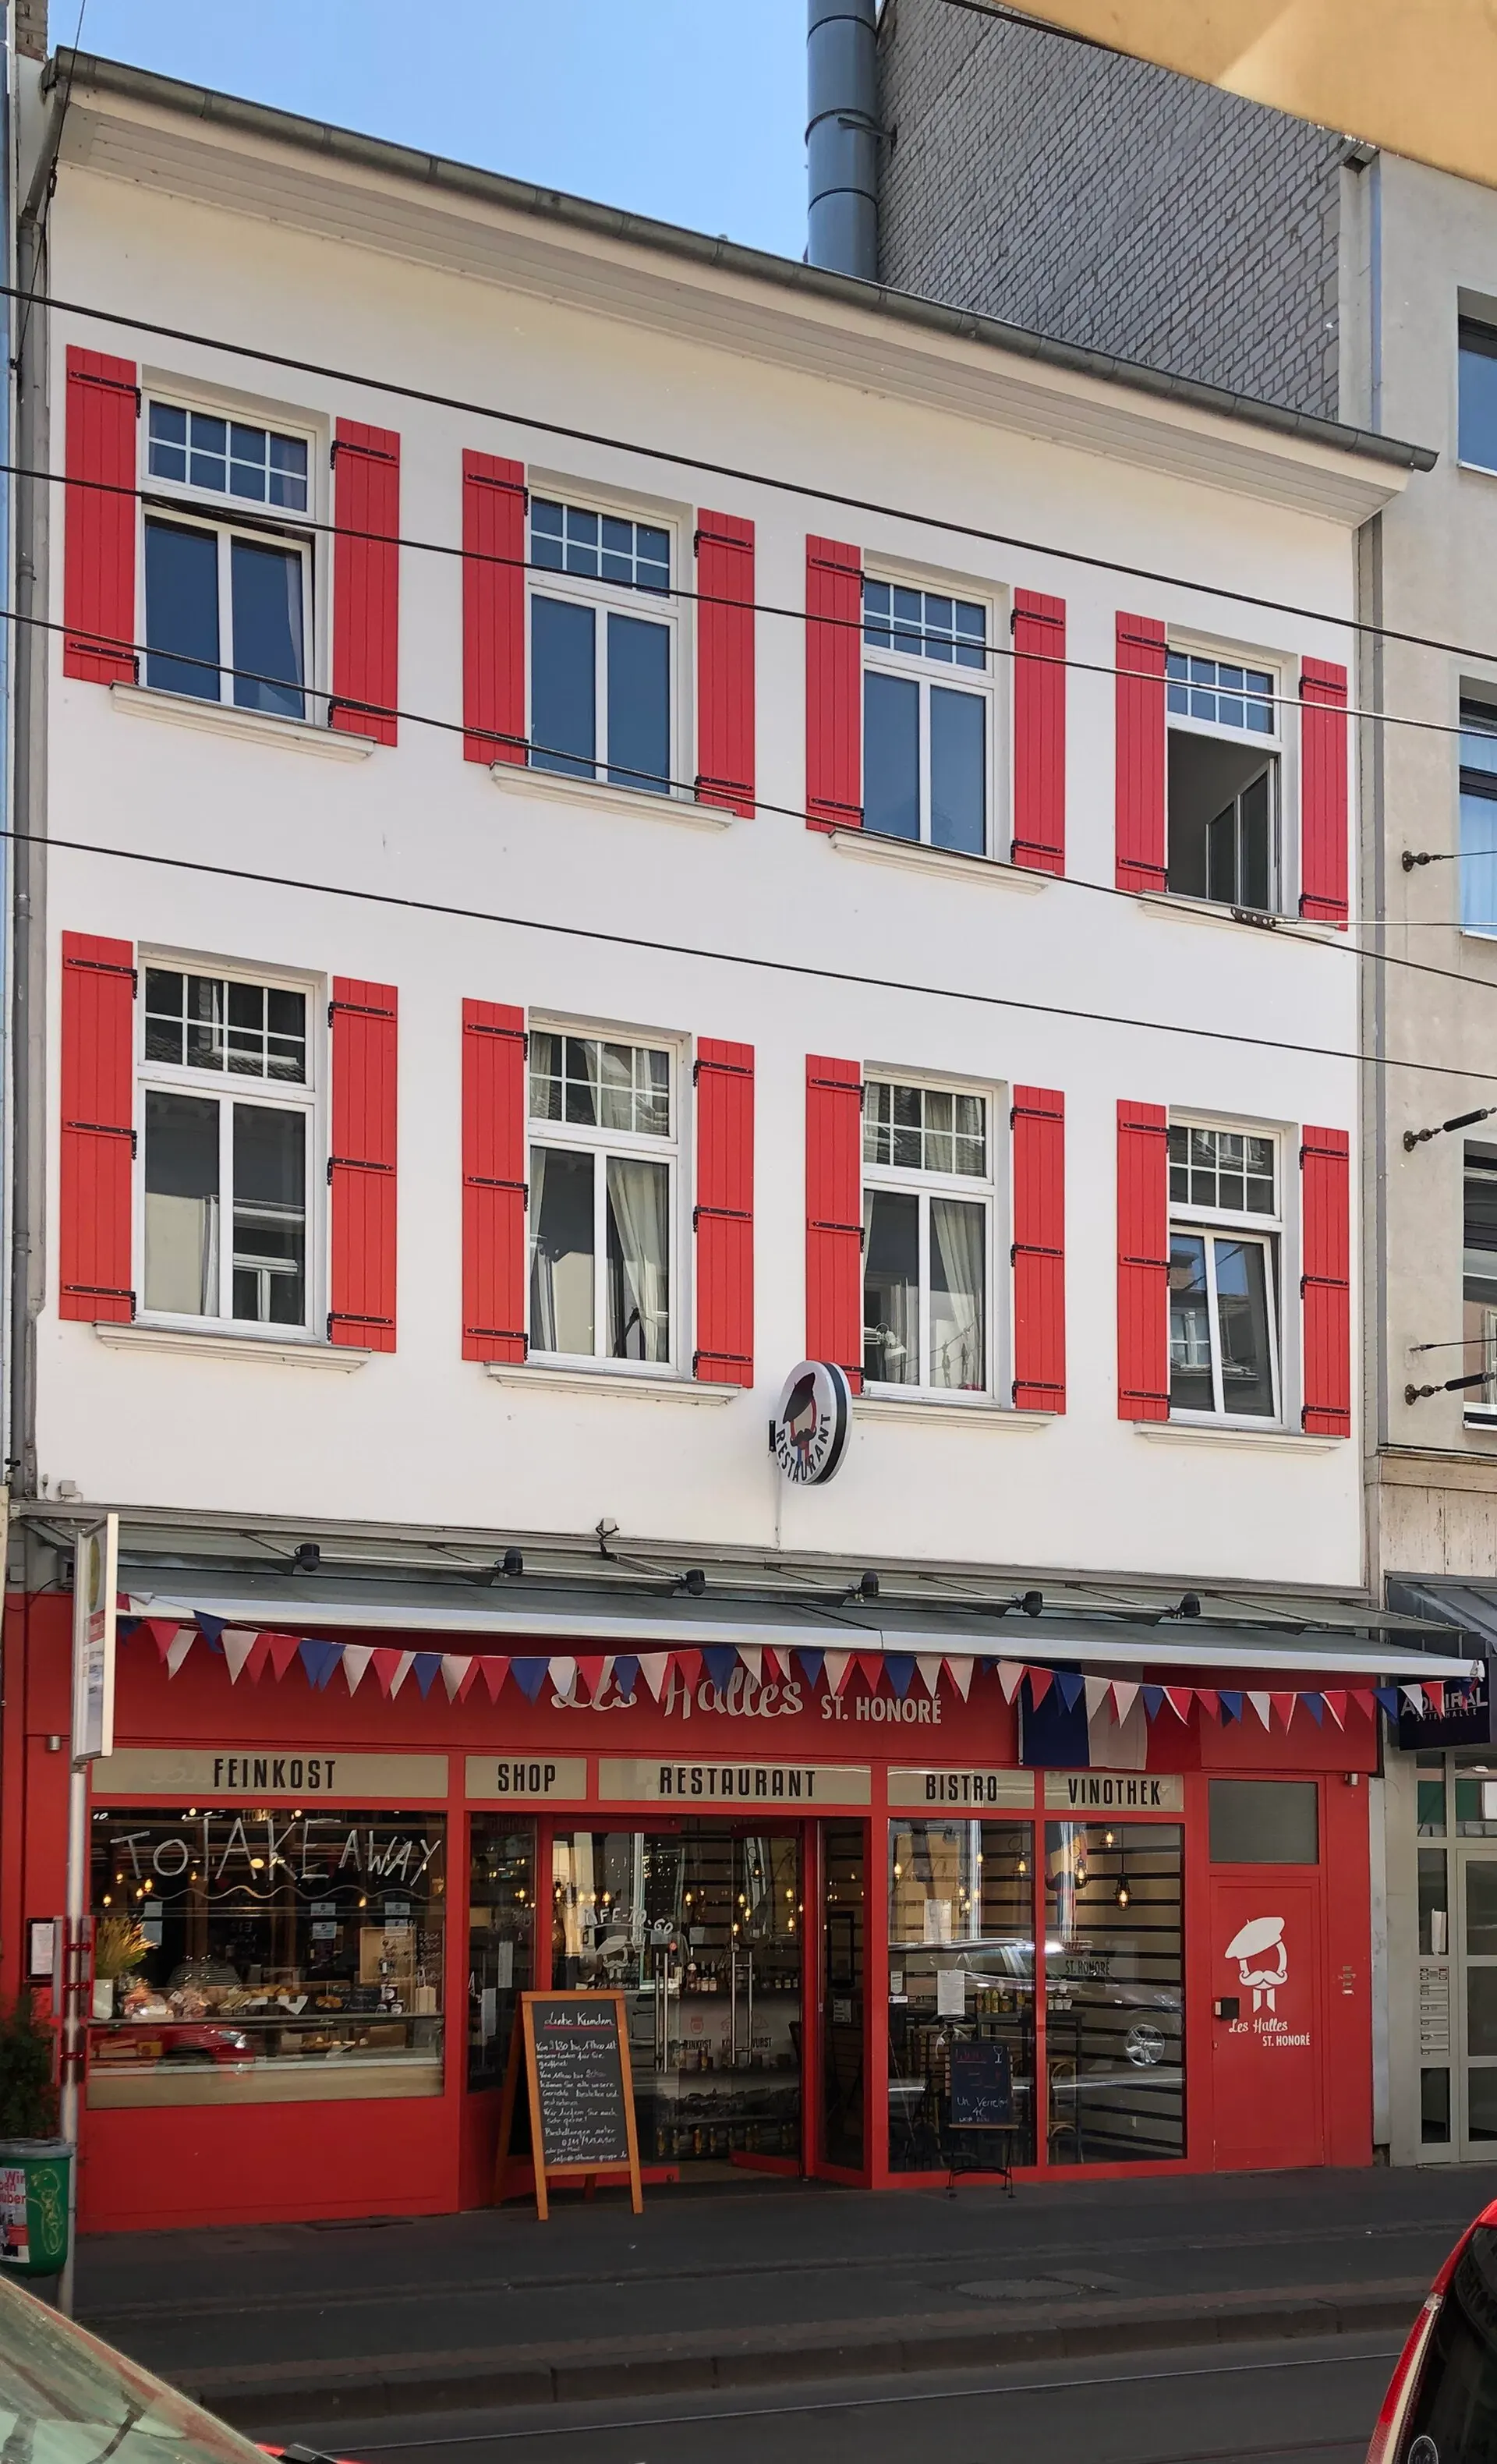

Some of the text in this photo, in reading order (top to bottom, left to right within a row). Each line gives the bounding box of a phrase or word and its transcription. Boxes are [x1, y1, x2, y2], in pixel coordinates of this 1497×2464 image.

[776, 1414, 831, 1482] RESTAURANT
[821, 1693, 942, 1724] ST. HONORÉ
[1400, 1687, 1488, 1716] ADIRAL
[214, 1758, 336, 1790] FEINKOST
[497, 1763, 556, 1793] SHOP
[660, 1766, 816, 1797] RESTAURANT
[925, 1774, 997, 1802] BISTRO
[1068, 1778, 1161, 1806] VINOTHEK
[182, 1815, 342, 1882] TAKE
[338, 1829, 441, 1886] AWAY
[1229, 2017, 1288, 2034] Les Halles
[1262, 2032, 1311, 2047] ST. HONORÉ
